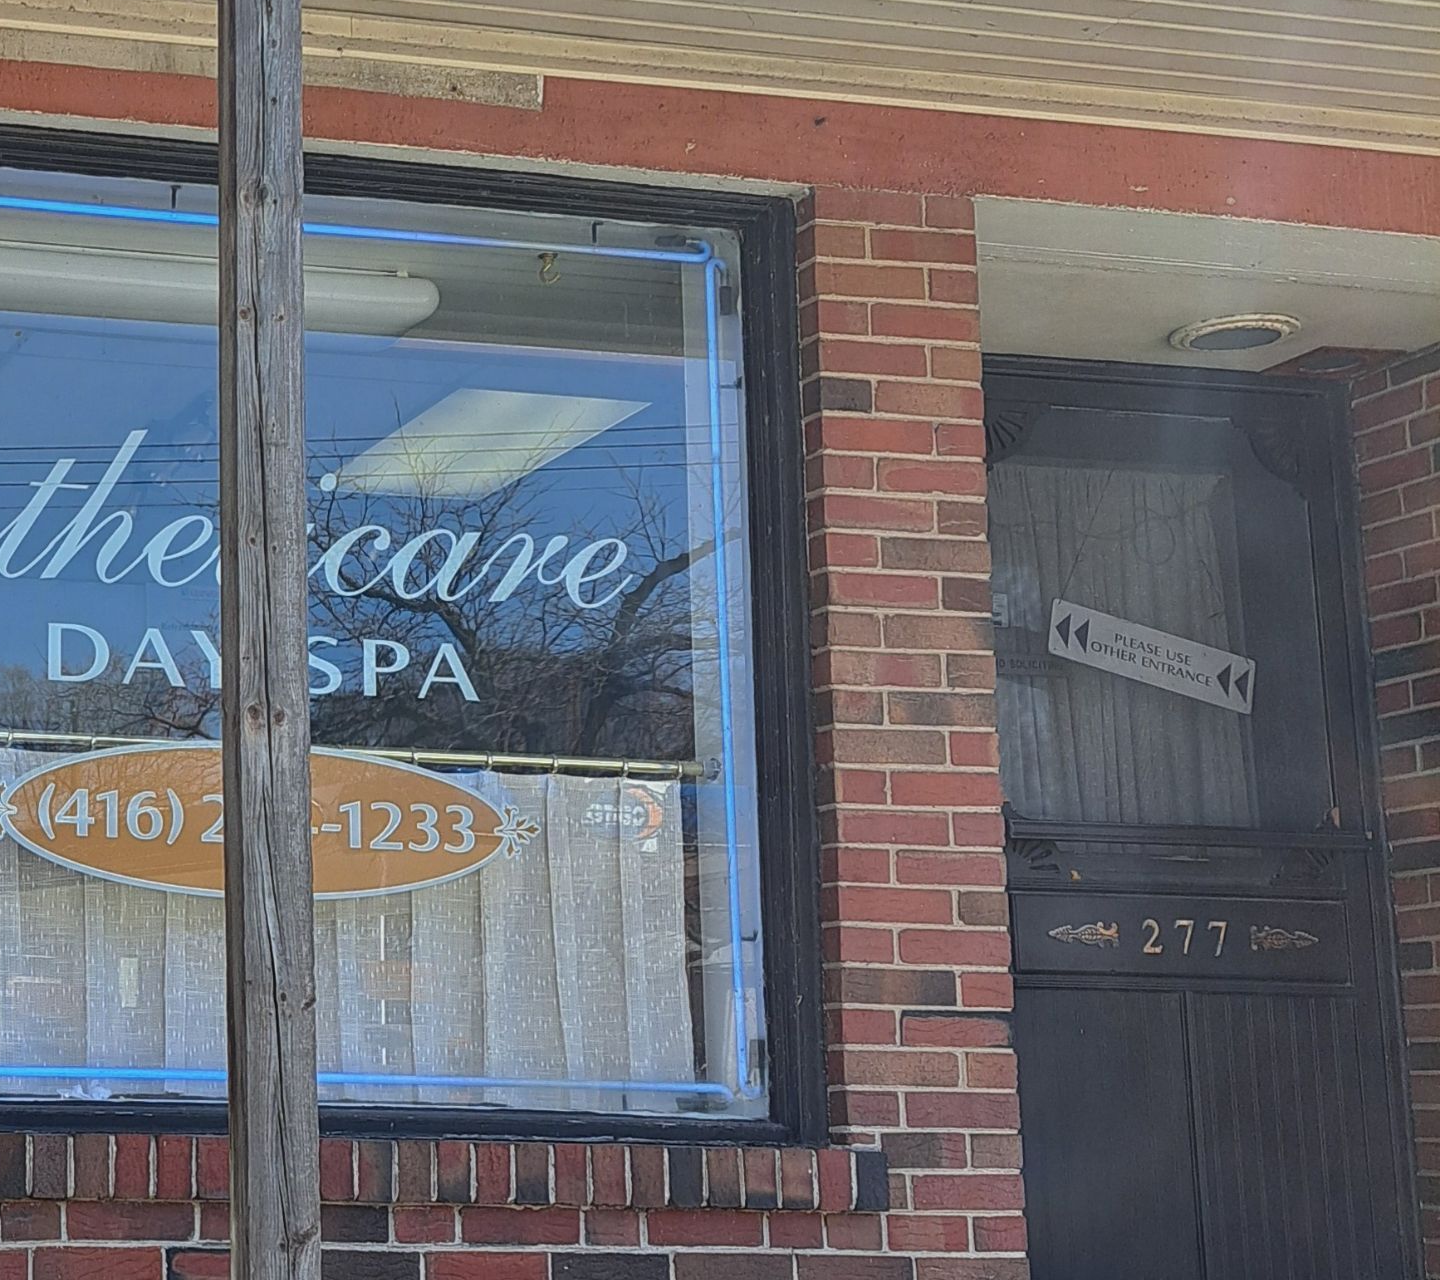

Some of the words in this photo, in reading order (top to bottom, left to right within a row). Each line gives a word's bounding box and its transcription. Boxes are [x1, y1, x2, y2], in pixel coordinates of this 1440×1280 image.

[308, 635, 481, 702] SPA
[1090, 641, 1137, 664] OTHER
[1141, 656, 1213, 687] ENTRANCE
[1114, 632, 1162, 658] PLEASE
[1166, 649, 1192, 666] USE
[37, 782, 184, 846] (416)
[201, 793, 477, 854] 2-1233
[1142, 918, 1227, 957] 277
